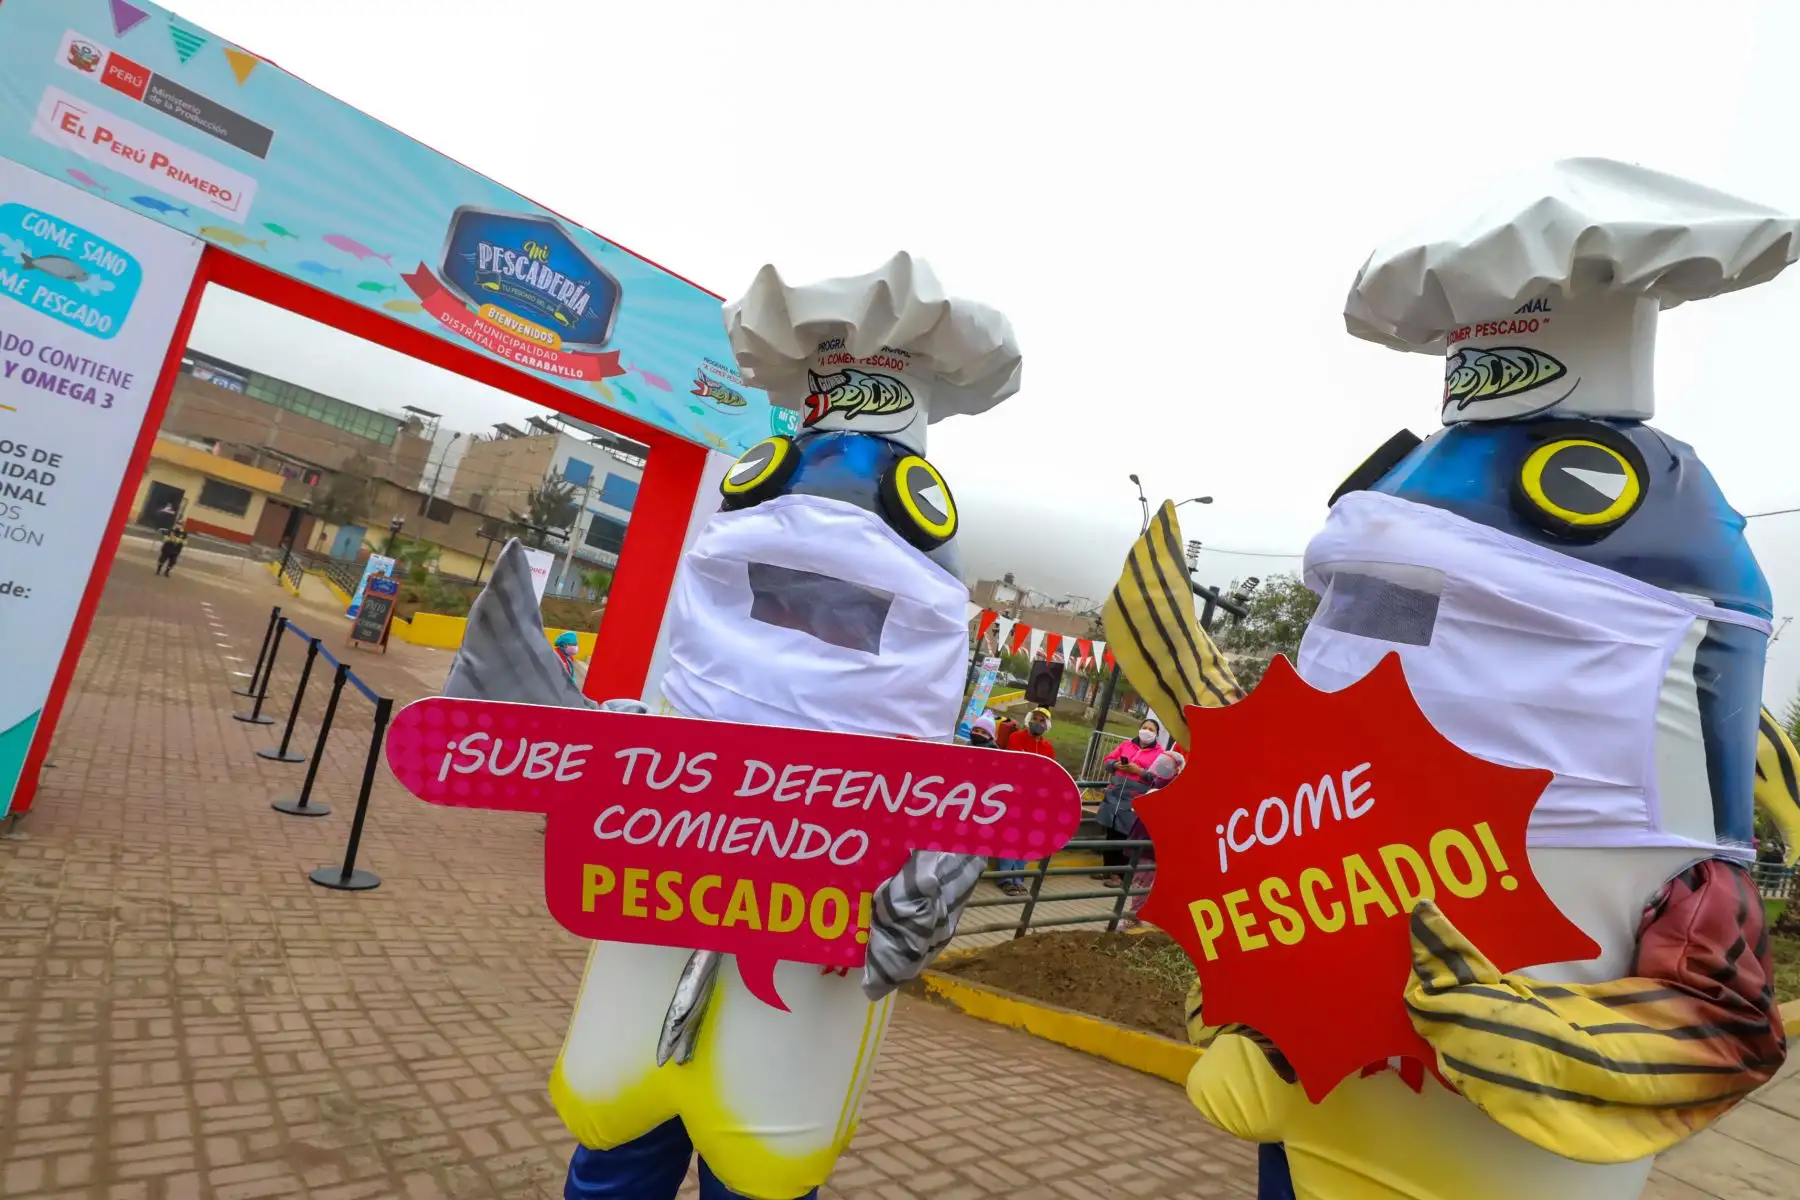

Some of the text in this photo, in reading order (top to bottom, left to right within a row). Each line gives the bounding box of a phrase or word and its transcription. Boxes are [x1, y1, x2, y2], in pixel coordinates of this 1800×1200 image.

[108, 64, 143, 88] PERÚ
[150, 85, 202, 114] Ministerio
[149, 94, 228, 137] de la Producción
[149, 152, 233, 203] PRIMERO
[21, 212, 128, 277] COME SANO
[478, 242, 590, 315] PESCADERÍA
[31, 285, 112, 333] PESCADO
[487, 306, 554, 344] BIENVENIDOS
[1514, 298, 1552, 314] NAL
[0, 330, 134, 391] DO CONTIENE
[440, 312, 584, 378] DISTRITAL DE CARABAYLLO
[473, 319, 558, 361] MUNICIPALIDAD
[817, 337, 846, 353] PROGRA
[4, 360, 115, 409] Y OMEGA 3
[31, 448, 63, 468] DE
[0, 480, 47, 506] NAL
[438, 731, 1015, 827] ¡SUBE TUS DEFENSAS
[593, 804, 869, 866] COMIENDO
[1215, 762, 1376, 873] ¡COME
[580, 863, 872, 944] PESCADO!
[1188, 821, 1519, 962] PESCADO!
